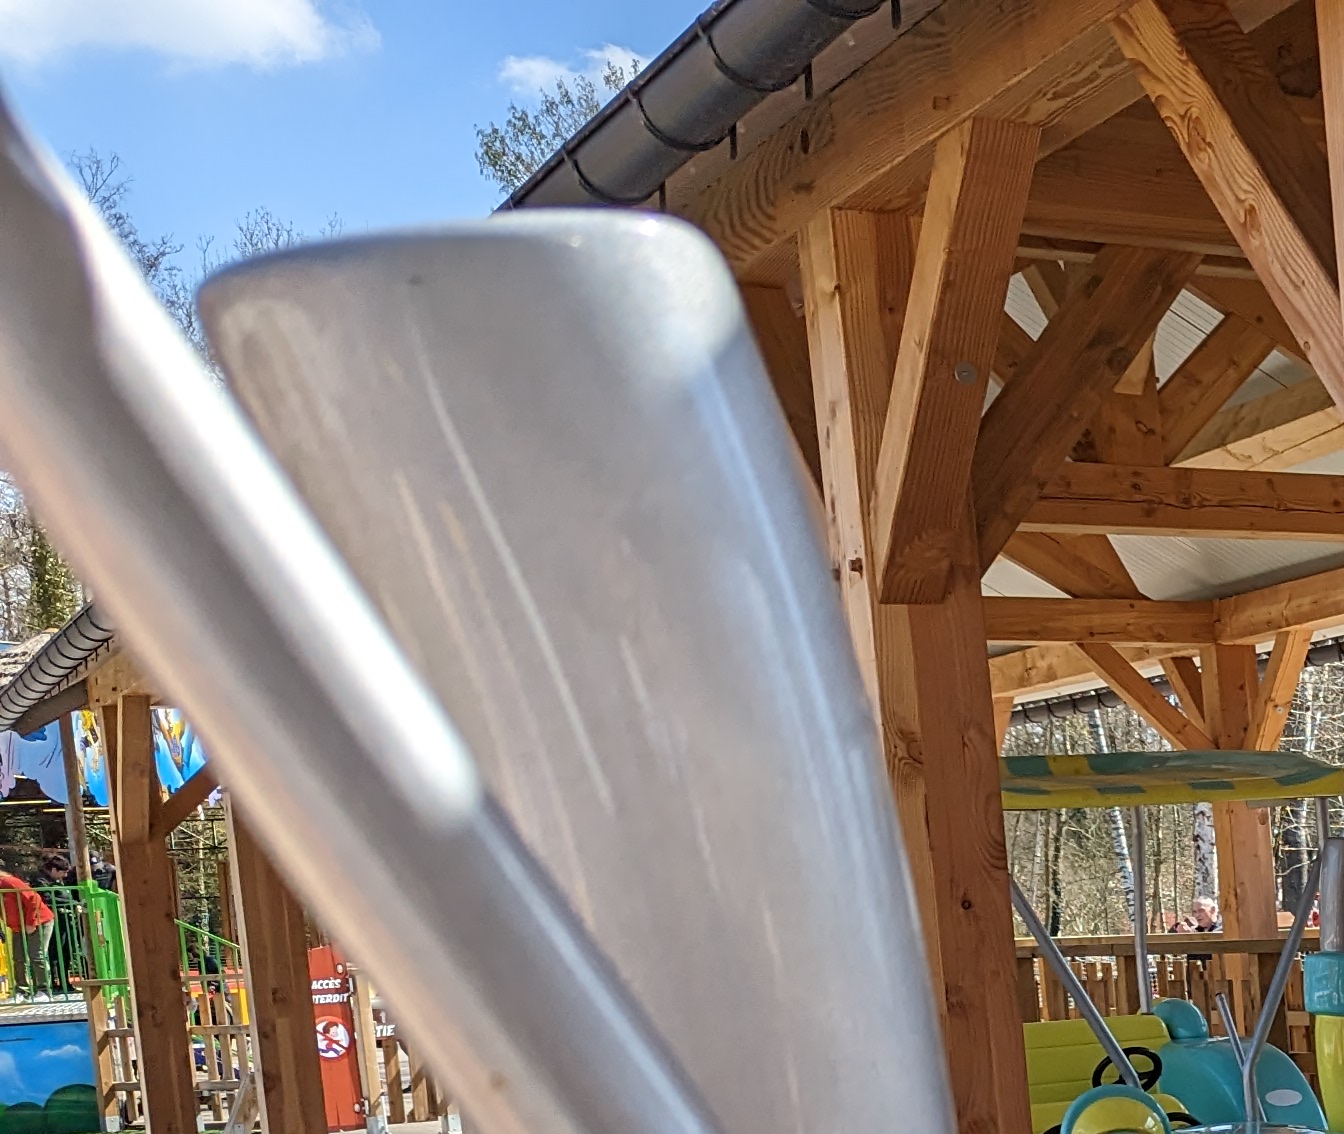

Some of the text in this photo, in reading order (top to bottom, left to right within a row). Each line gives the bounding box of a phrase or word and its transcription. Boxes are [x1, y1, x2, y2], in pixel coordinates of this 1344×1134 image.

[311, 976, 341, 989] ACCÈS
[312, 993, 348, 1004] TERDIT
[373, 1024, 396, 1037] TIE
